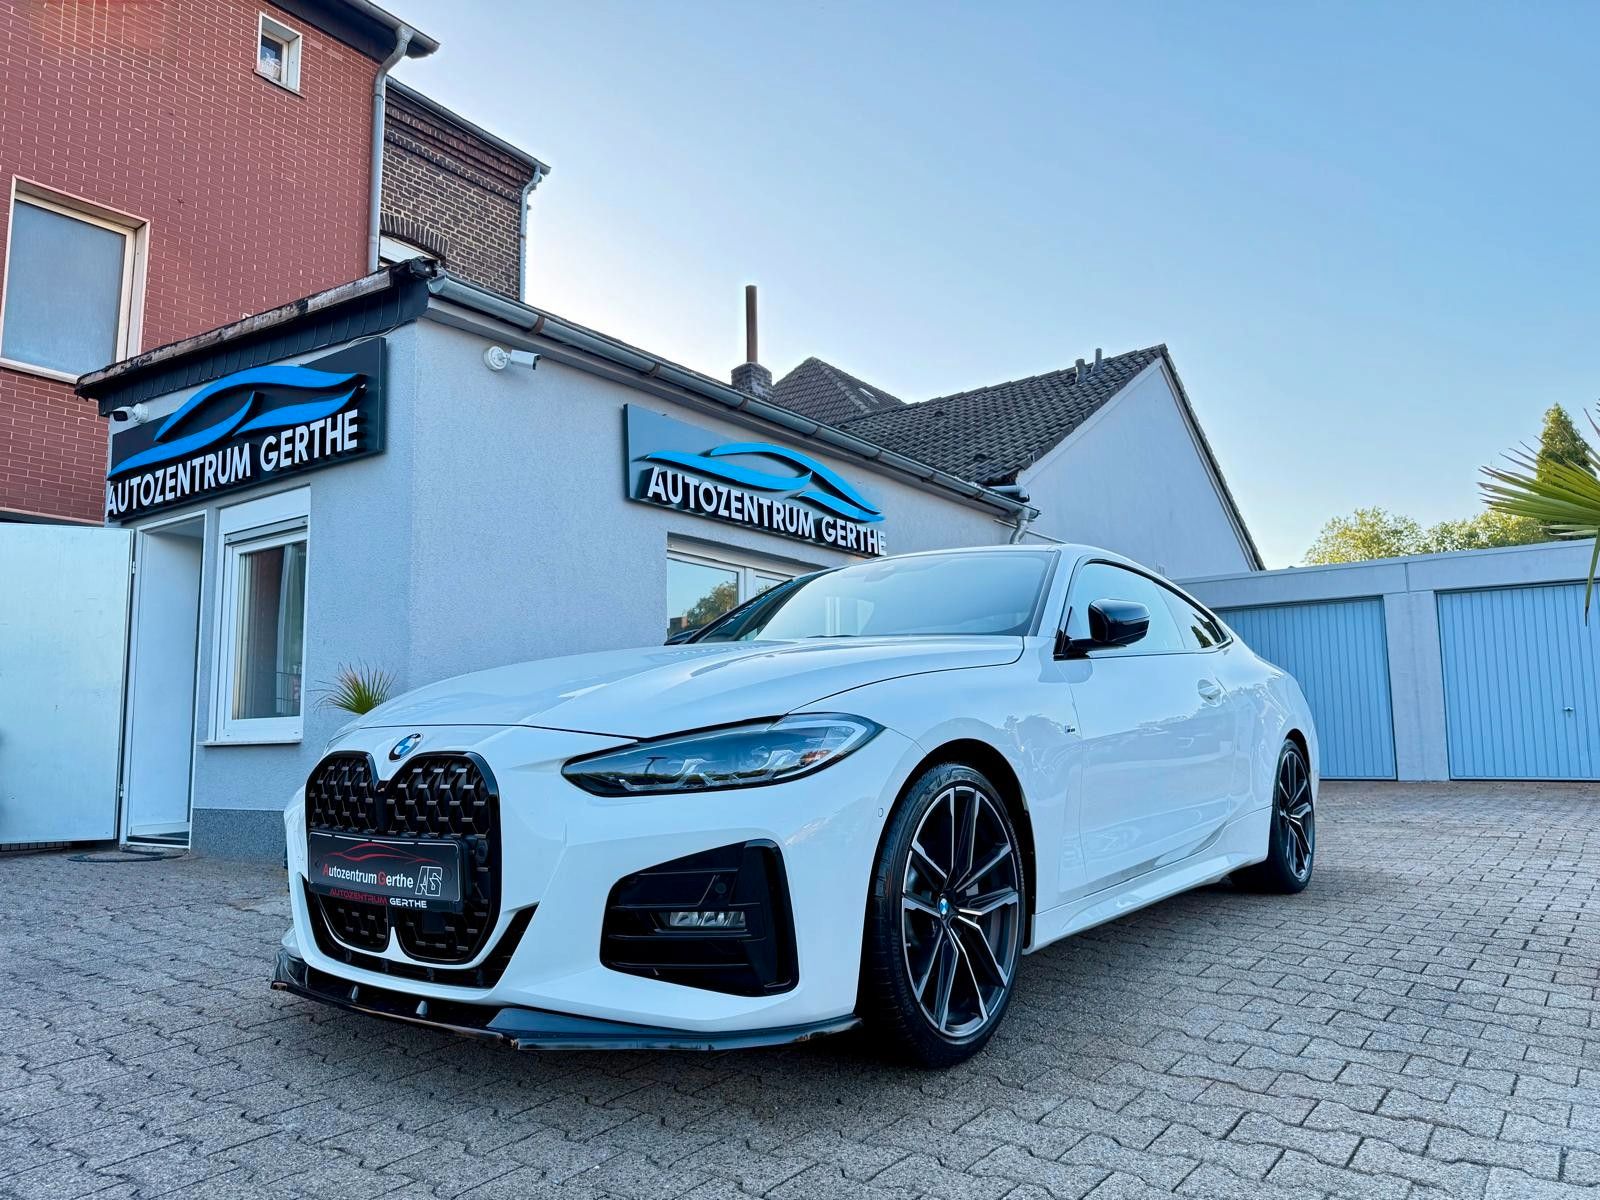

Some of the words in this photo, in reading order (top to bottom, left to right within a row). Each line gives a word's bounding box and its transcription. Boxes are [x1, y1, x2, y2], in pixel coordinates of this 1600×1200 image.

[104, 442, 251, 518] AUTOZENTRUM
[259, 409, 358, 472] GERTHE
[647, 465, 816, 540] AUTOZENTRUM
[821, 516, 888, 556] GERTHE
[330, 888, 388, 905] AUTOZENTRUM
[389, 897, 428, 909] GERTHE
